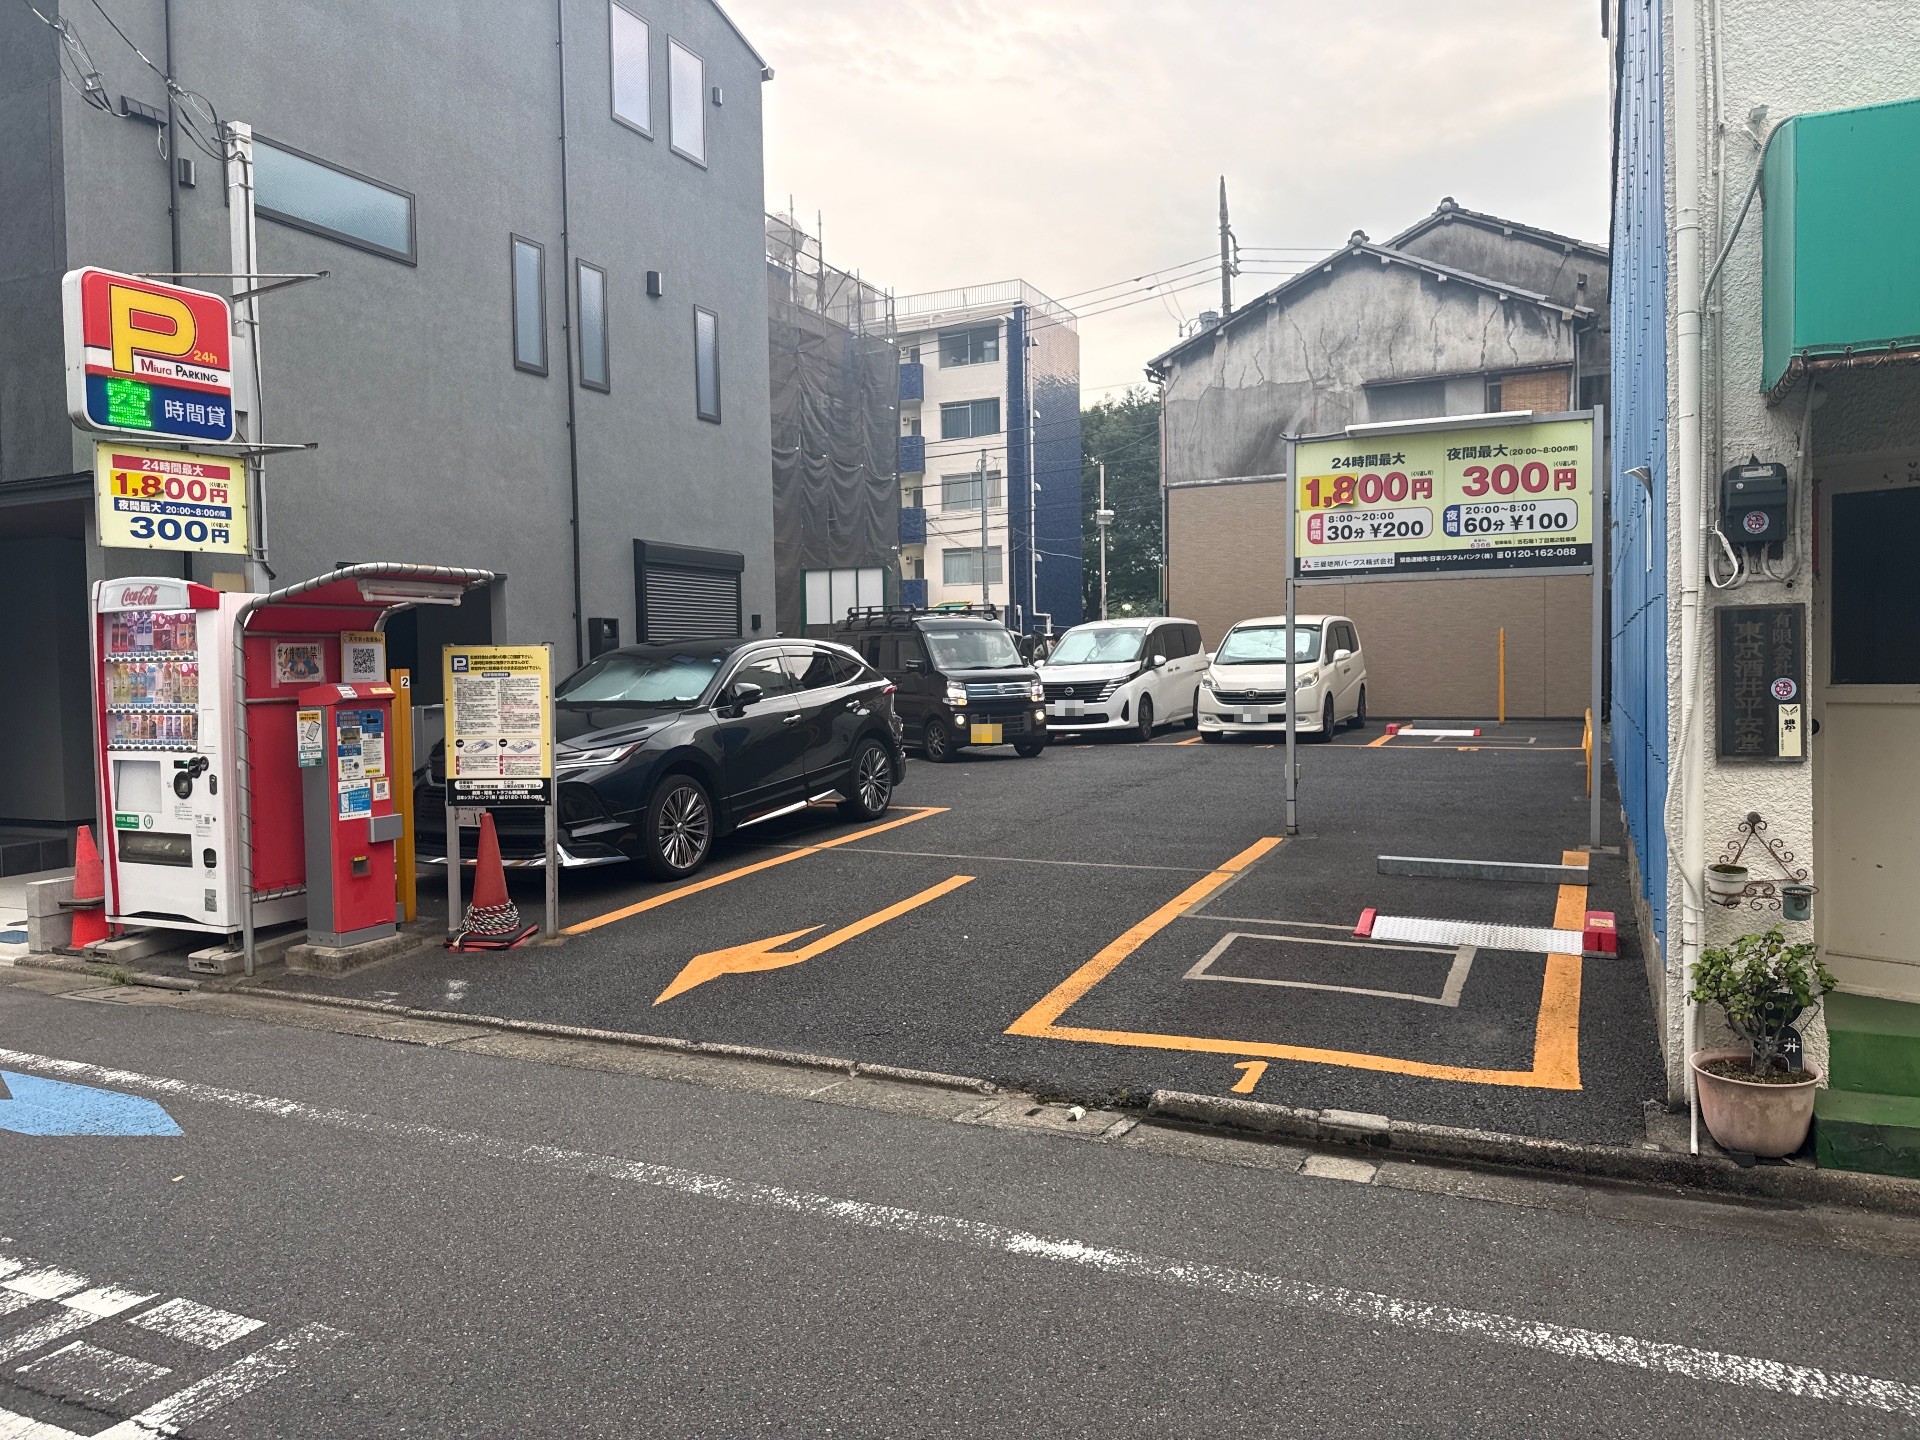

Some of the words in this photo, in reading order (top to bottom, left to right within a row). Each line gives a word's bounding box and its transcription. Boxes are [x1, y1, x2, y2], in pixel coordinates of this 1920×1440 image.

[108, 282, 197, 374] P
[194, 349, 218, 365] 24h
[140, 357, 172, 376] Miura
[175, 364, 218, 383] PARKING
[164, 399, 226, 428] 時間貸
[1331, 452, 1406, 470] 24時間最大
[1446, 443, 1509, 462] 夜間最大
[142, 459, 204, 477] 24時間最大
[1461, 461, 1577, 498] 300円
[118, 500, 161, 513] 夜間最大
[130, 516, 230, 544] 300円
[1310, 518, 1321, 541] 昼間
[1446, 511, 1458, 534] 夜間
[1463, 517, 1504, 534] 60分
[1327, 523, 1365, 542] 30分
[1504, 548, 1577, 559] 0120-162-088
[1773, 612, 1793, 676] 有限会社
[454, 658, 466, 670] P
[402, 677, 409, 687] 2
[1231, 1061, 1269, 1094] 1
